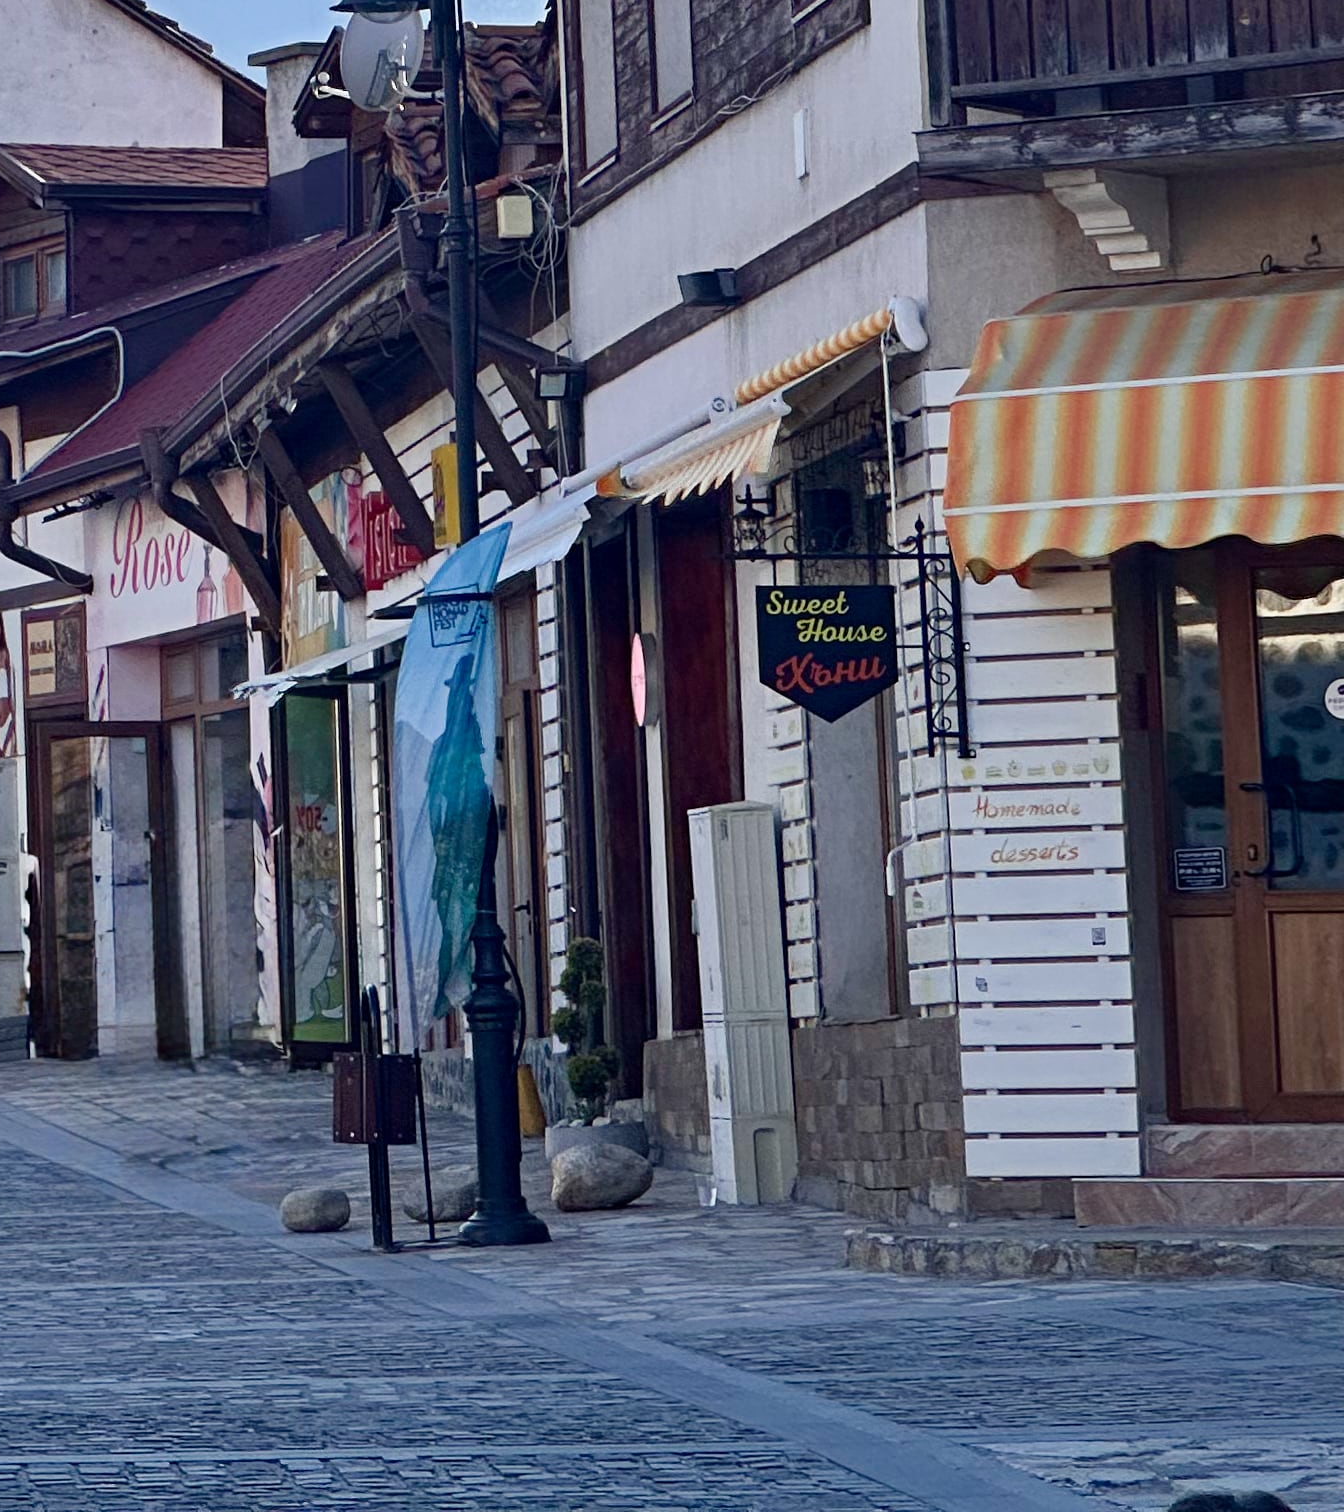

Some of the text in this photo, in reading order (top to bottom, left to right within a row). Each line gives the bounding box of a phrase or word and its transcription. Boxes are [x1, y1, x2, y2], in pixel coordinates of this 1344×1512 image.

[110, 496, 190, 598] Rose
[766, 590, 849, 615] Sweet
[434, 619, 456, 631] FEST
[796, 618, 887, 642] House
[972, 795, 1081, 820] Homemade
[991, 838, 1079, 864] desserts
